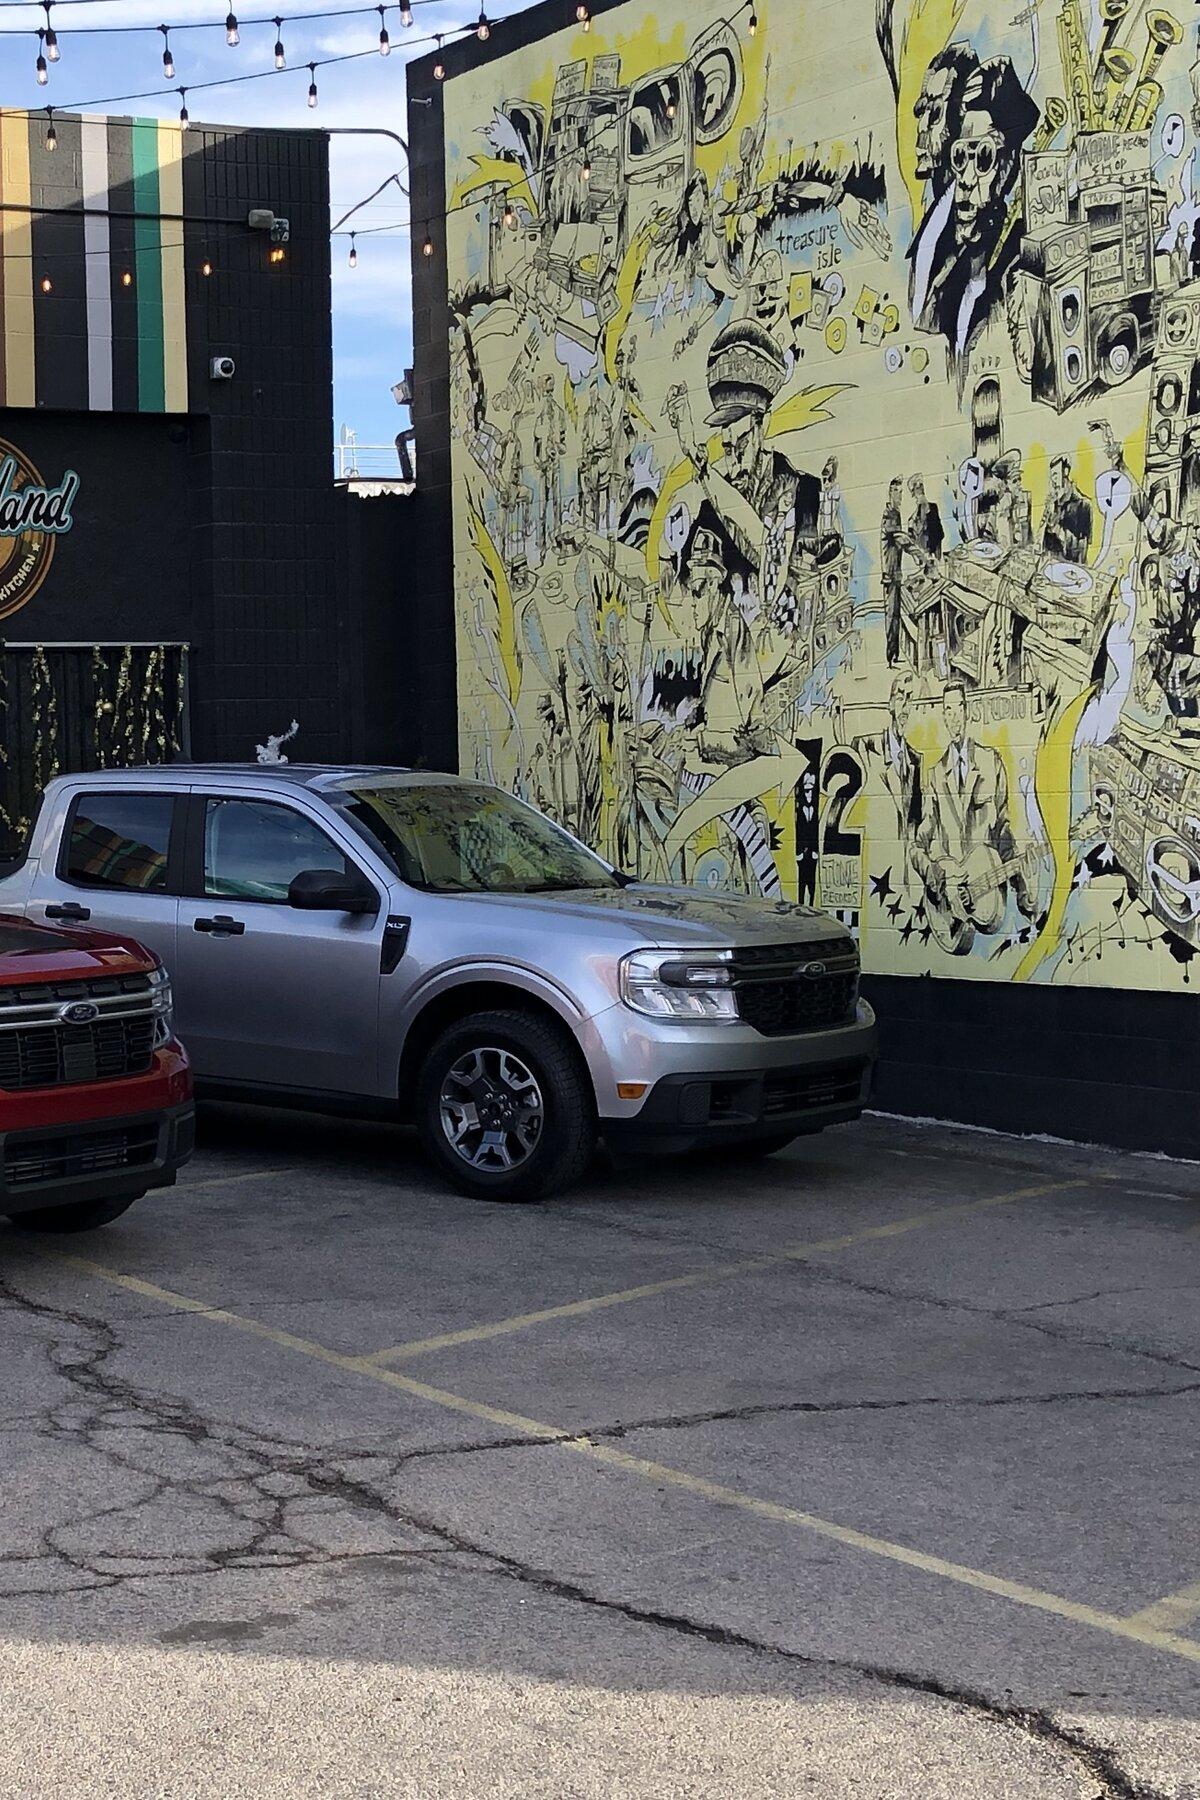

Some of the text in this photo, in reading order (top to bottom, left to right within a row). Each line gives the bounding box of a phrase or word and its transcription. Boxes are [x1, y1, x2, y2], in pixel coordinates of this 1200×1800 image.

[1092, 158, 1127, 175] SHOP
[1088, 193, 1114, 203] TAPES
[776, 224, 838, 255] treasure
[817, 244, 841, 270] isle
[1092, 285, 1119, 300] ROOTS
[1034, 690, 1043, 714] 1
[822, 752, 862, 856] 2
[822, 859, 859, 889] TONE
[822, 890, 858, 904] RECORDS
